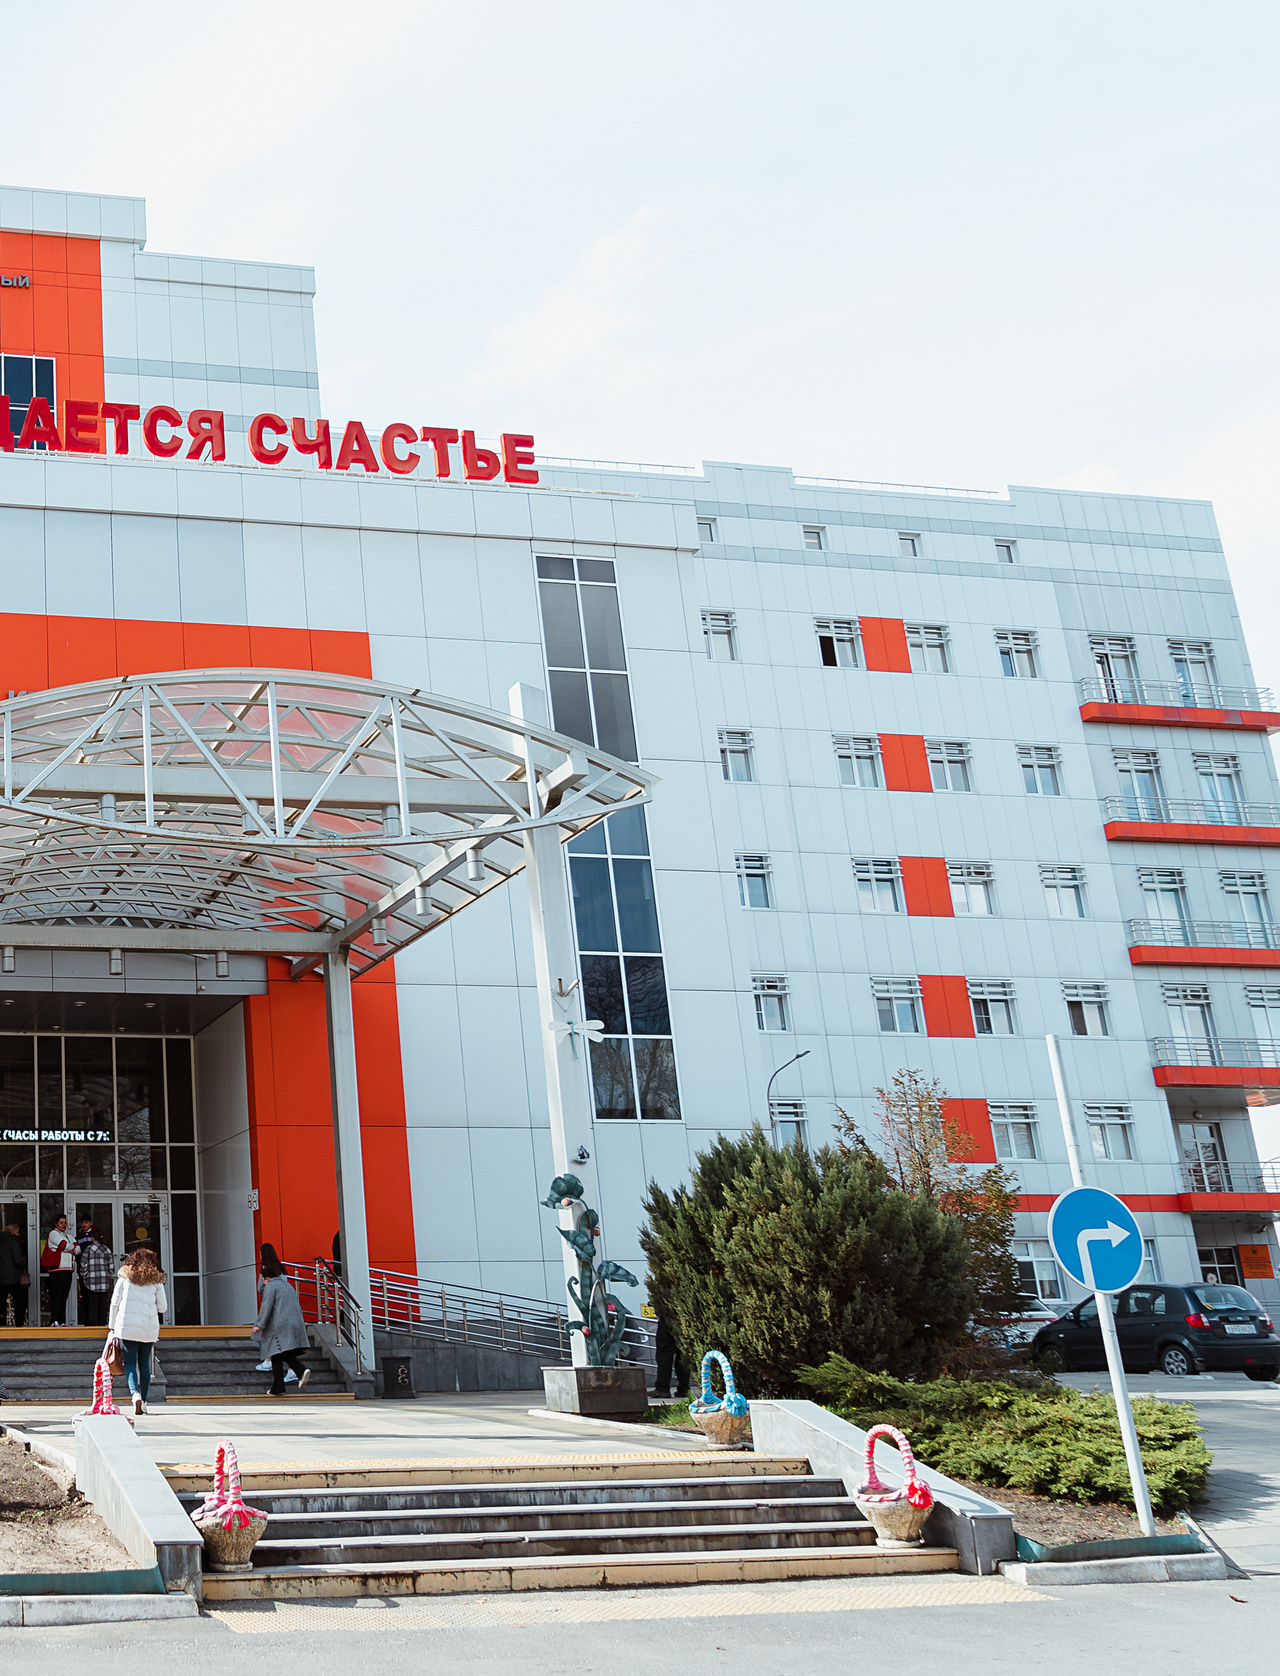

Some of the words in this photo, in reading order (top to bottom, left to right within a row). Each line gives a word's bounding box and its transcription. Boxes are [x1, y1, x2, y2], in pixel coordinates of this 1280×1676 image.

[247, 412, 540, 484] СЧАСТЬЕ
[3, 1130, 39, 1141] (ЧАСЫ
[41, 1130, 84, 1141] РАБОТЫ
[87, 1131, 95, 1141] С
